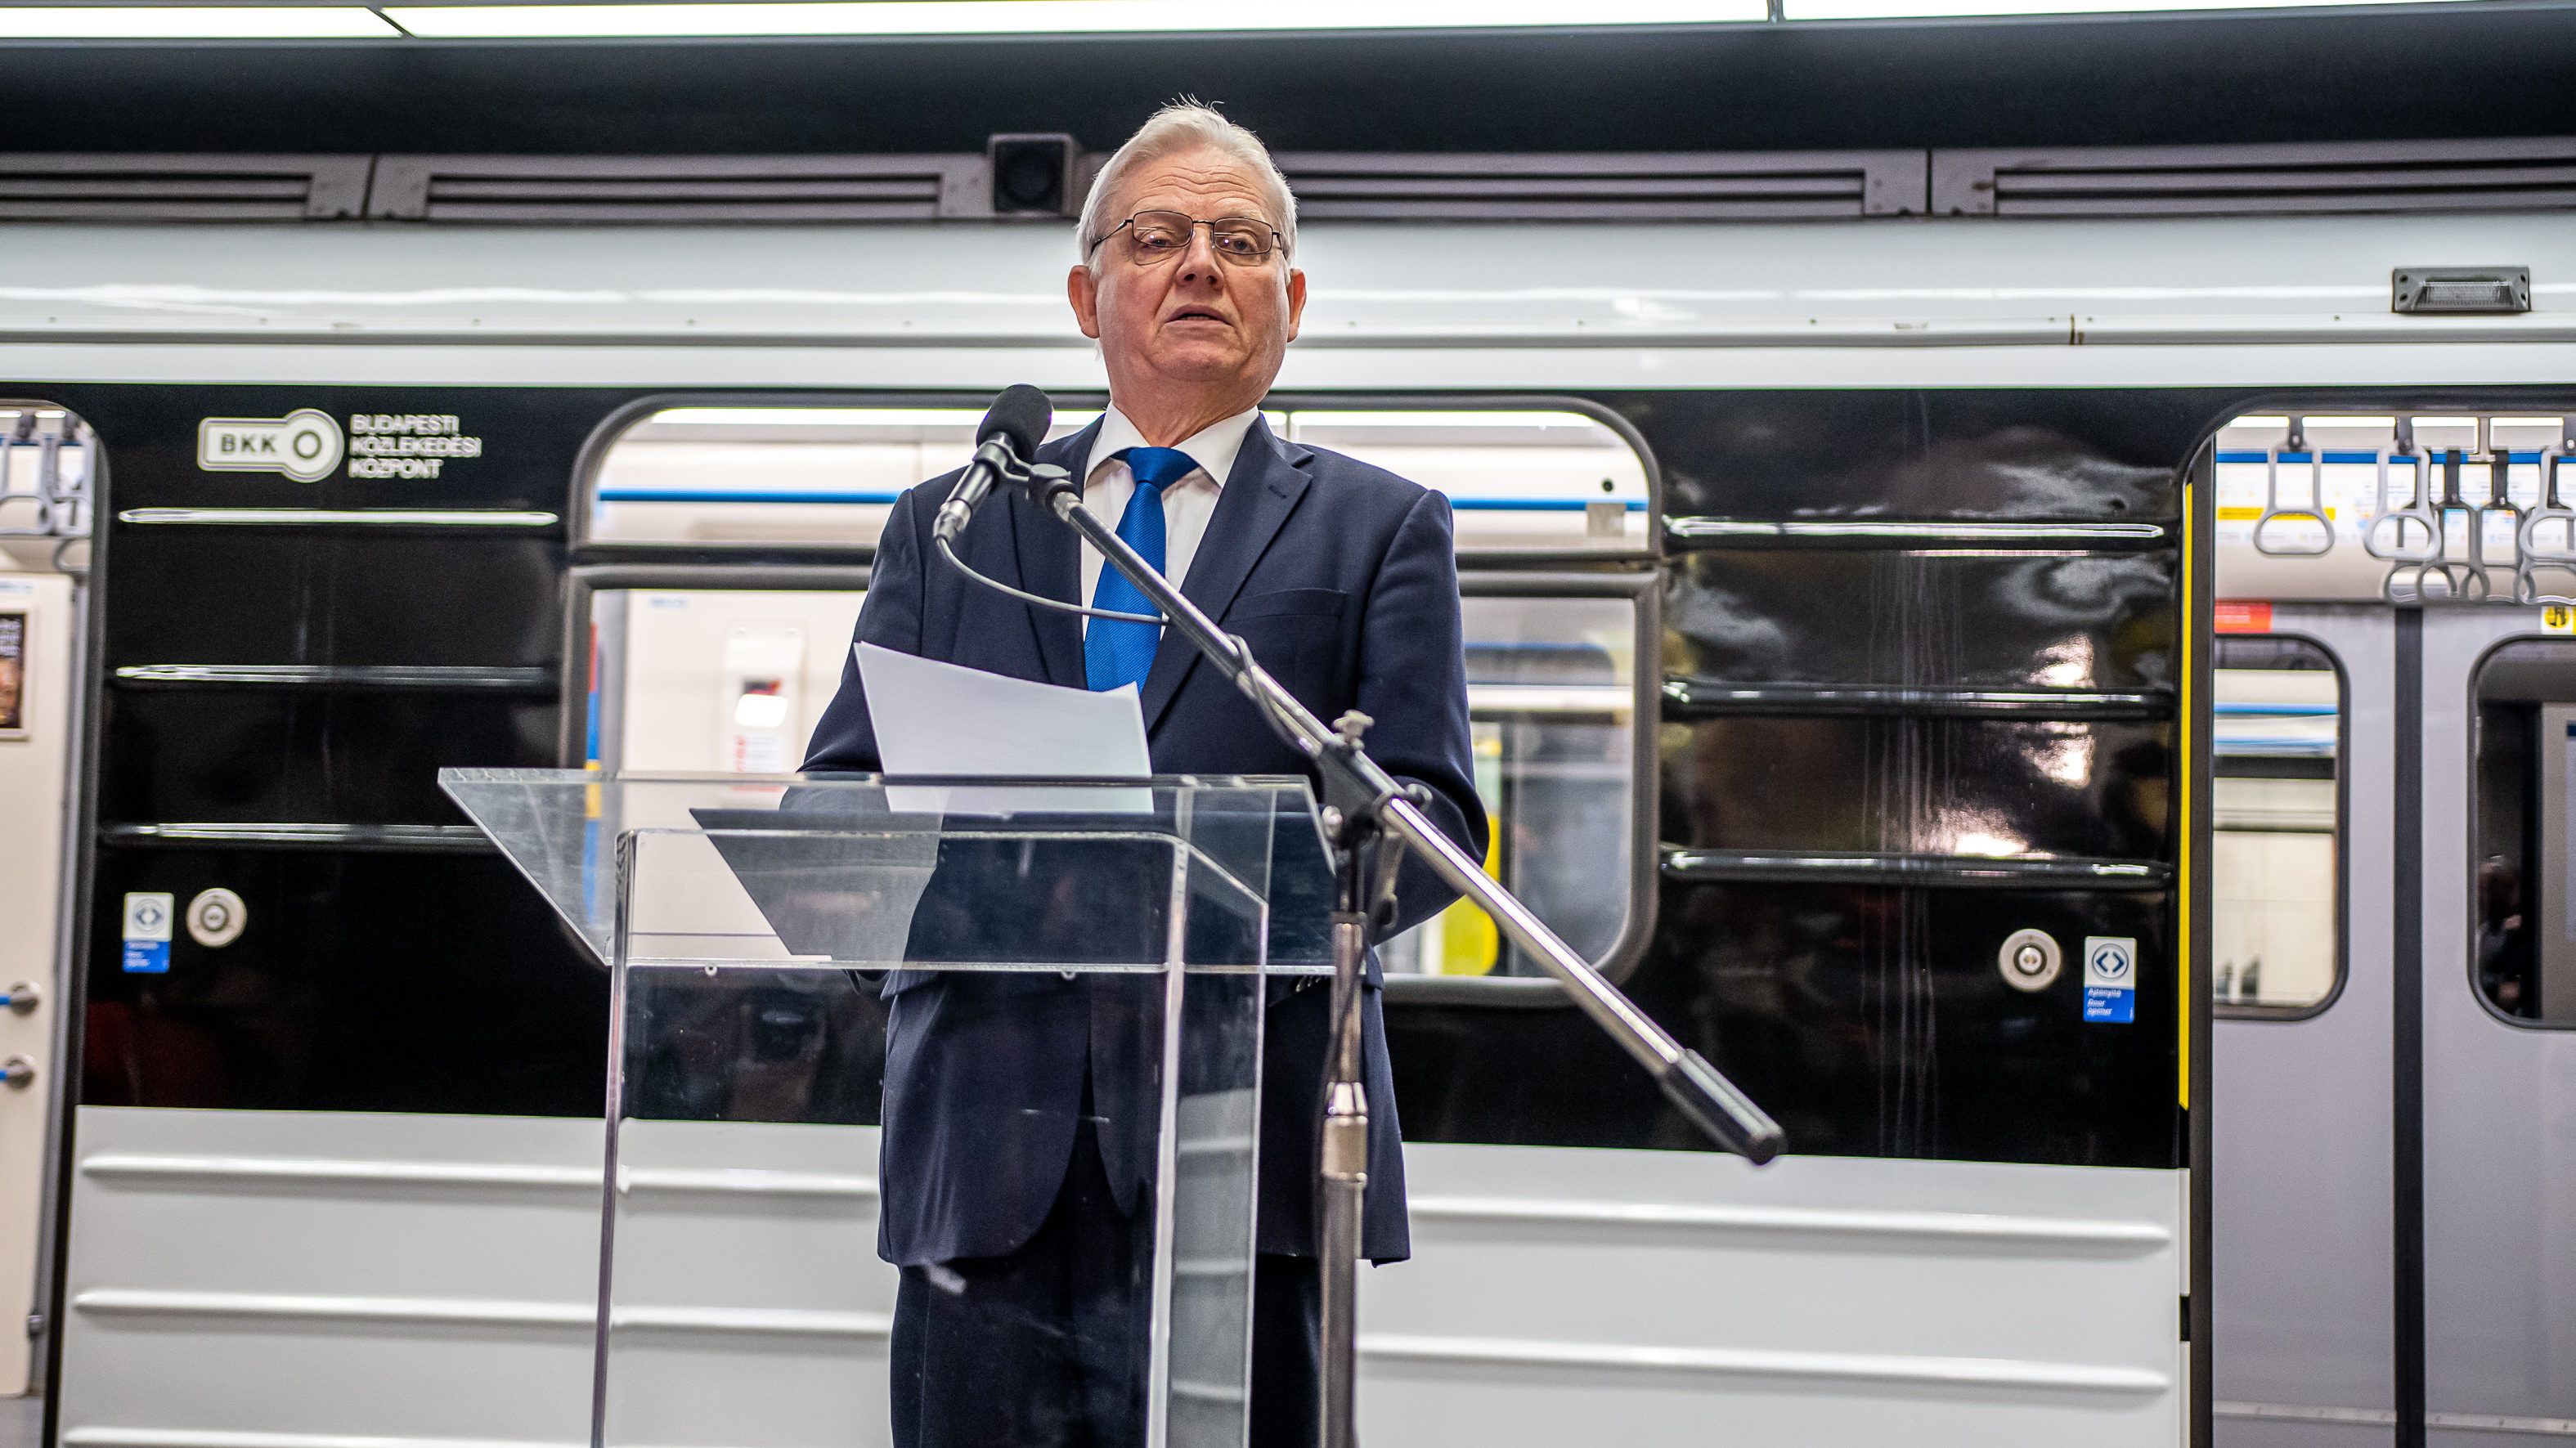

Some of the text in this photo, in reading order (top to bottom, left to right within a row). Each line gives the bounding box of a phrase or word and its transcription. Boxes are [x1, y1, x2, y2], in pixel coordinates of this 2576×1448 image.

[350, 414, 460, 435] BUDAPESTI
[221, 433, 277, 453] BKK
[348, 456, 445, 479] KÖZPONT
